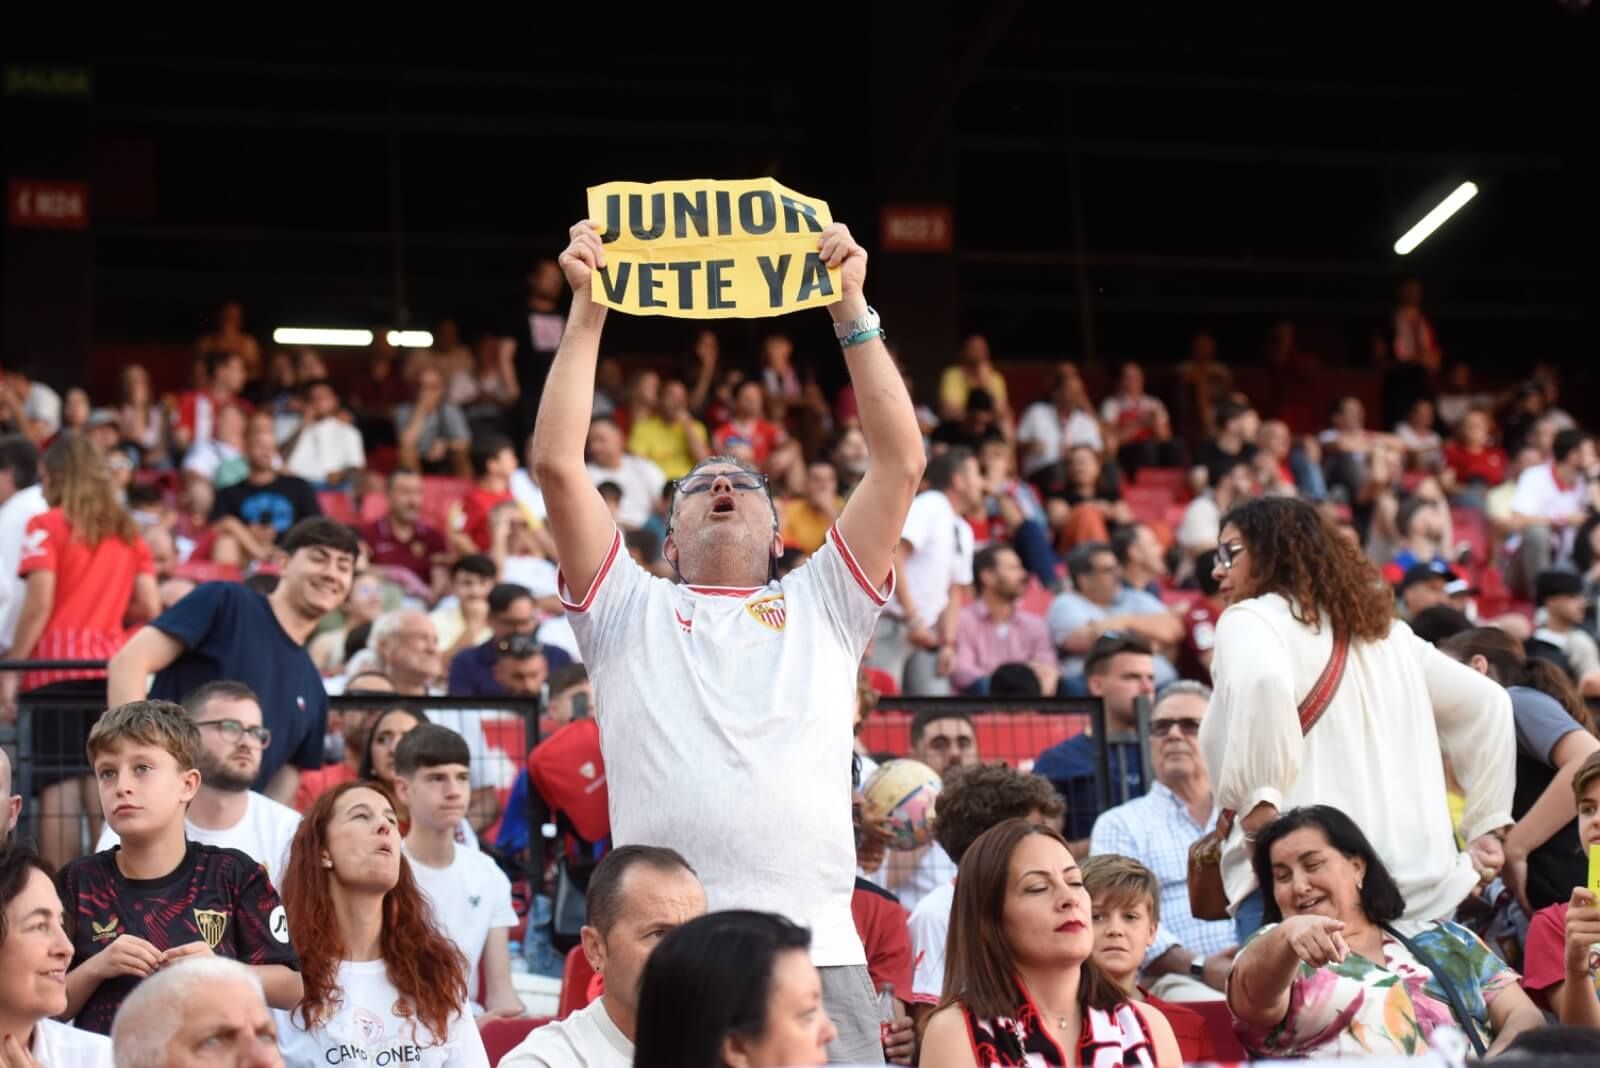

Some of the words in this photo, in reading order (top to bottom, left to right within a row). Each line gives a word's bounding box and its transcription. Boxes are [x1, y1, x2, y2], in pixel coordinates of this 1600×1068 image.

[600, 190, 824, 243] JUNIOR
[597, 258, 736, 310] VETE
[757, 251, 834, 308] YA
